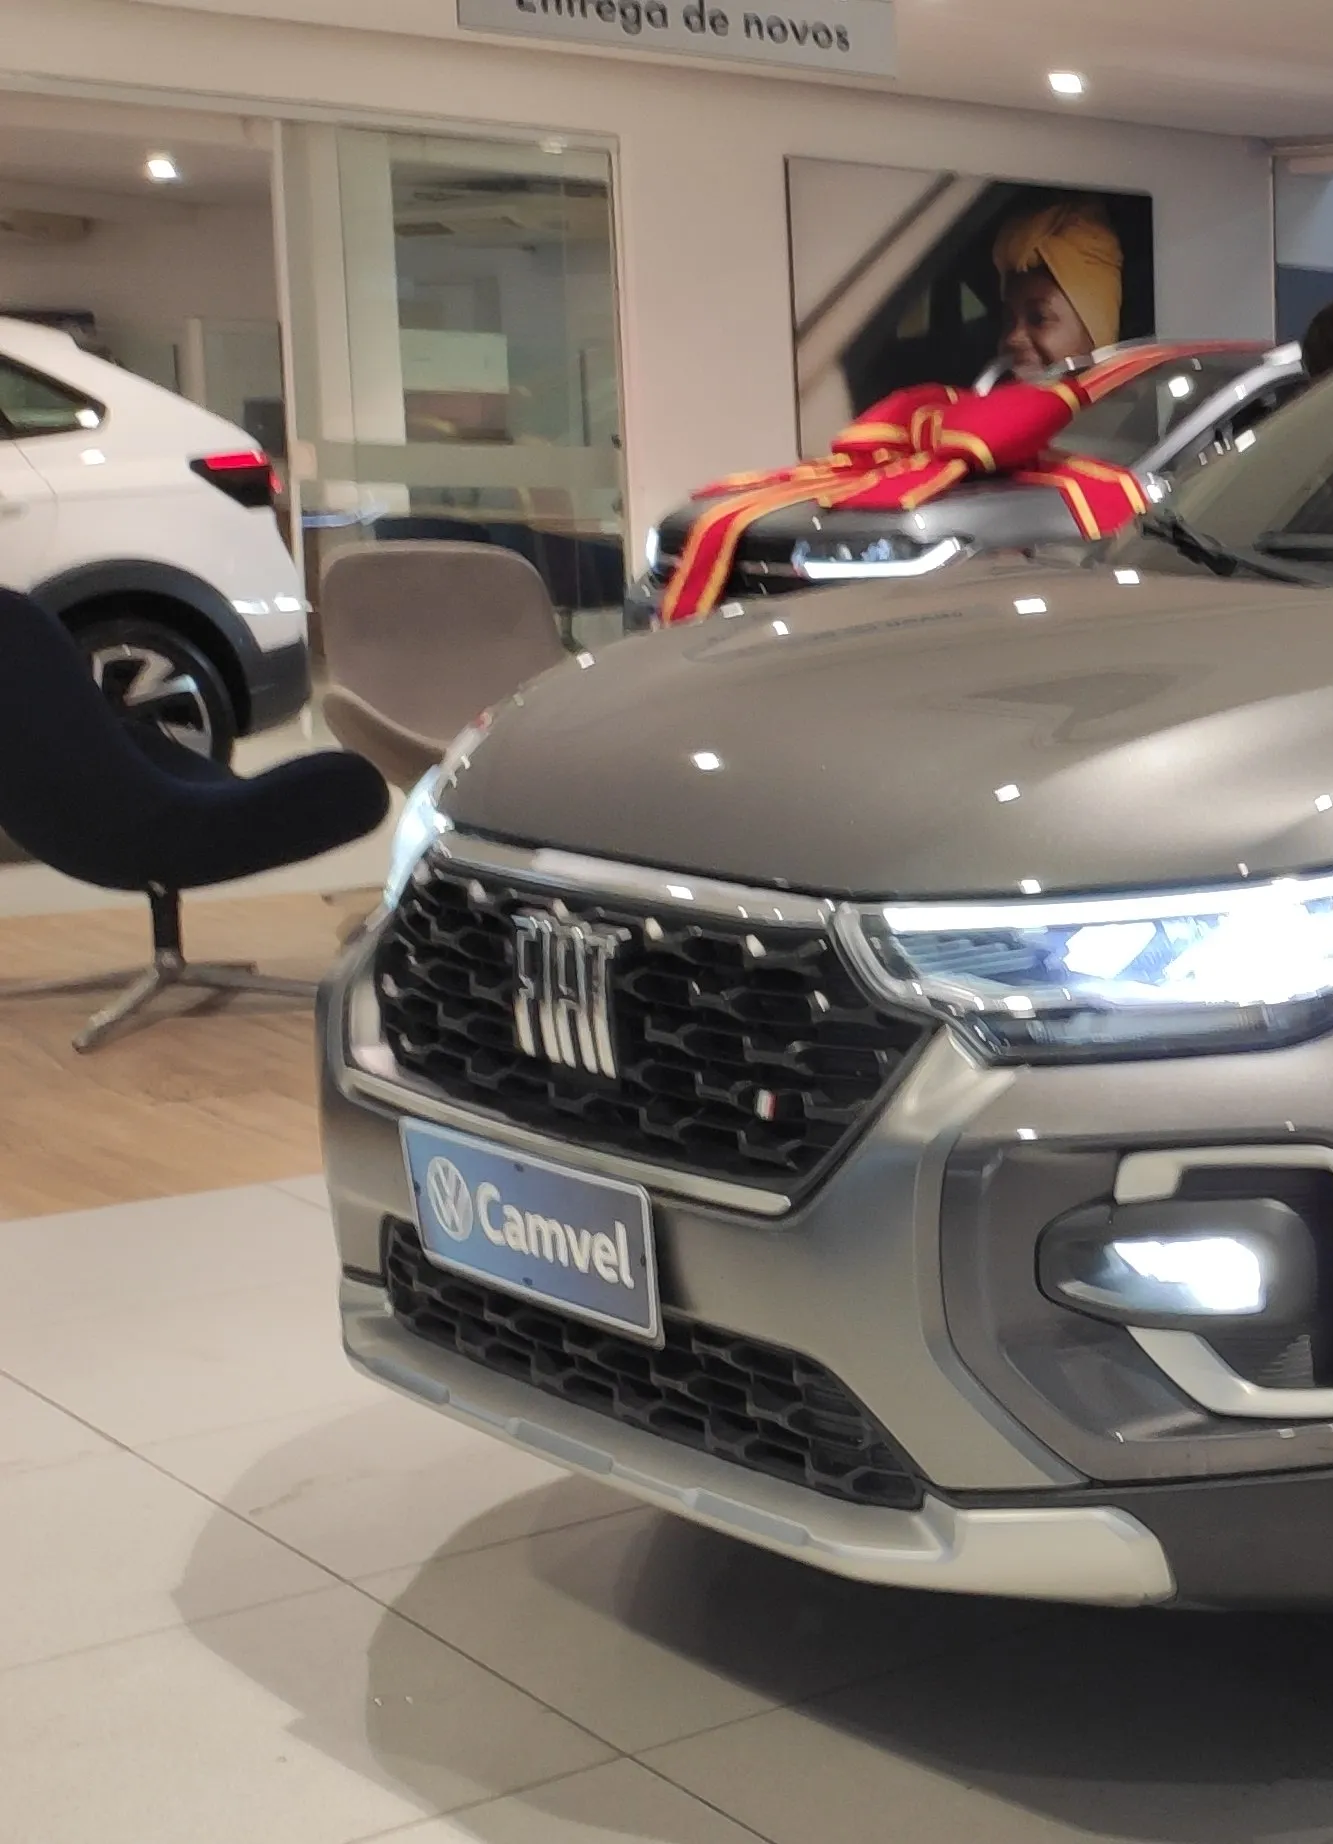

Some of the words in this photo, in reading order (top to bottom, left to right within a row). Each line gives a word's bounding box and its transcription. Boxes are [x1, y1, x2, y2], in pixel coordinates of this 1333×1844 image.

[683, 0, 729, 37] de
[743, 12, 850, 52] novos
[511, 908, 632, 1080] FIAT
[476, 1181, 635, 1290] Camvel
